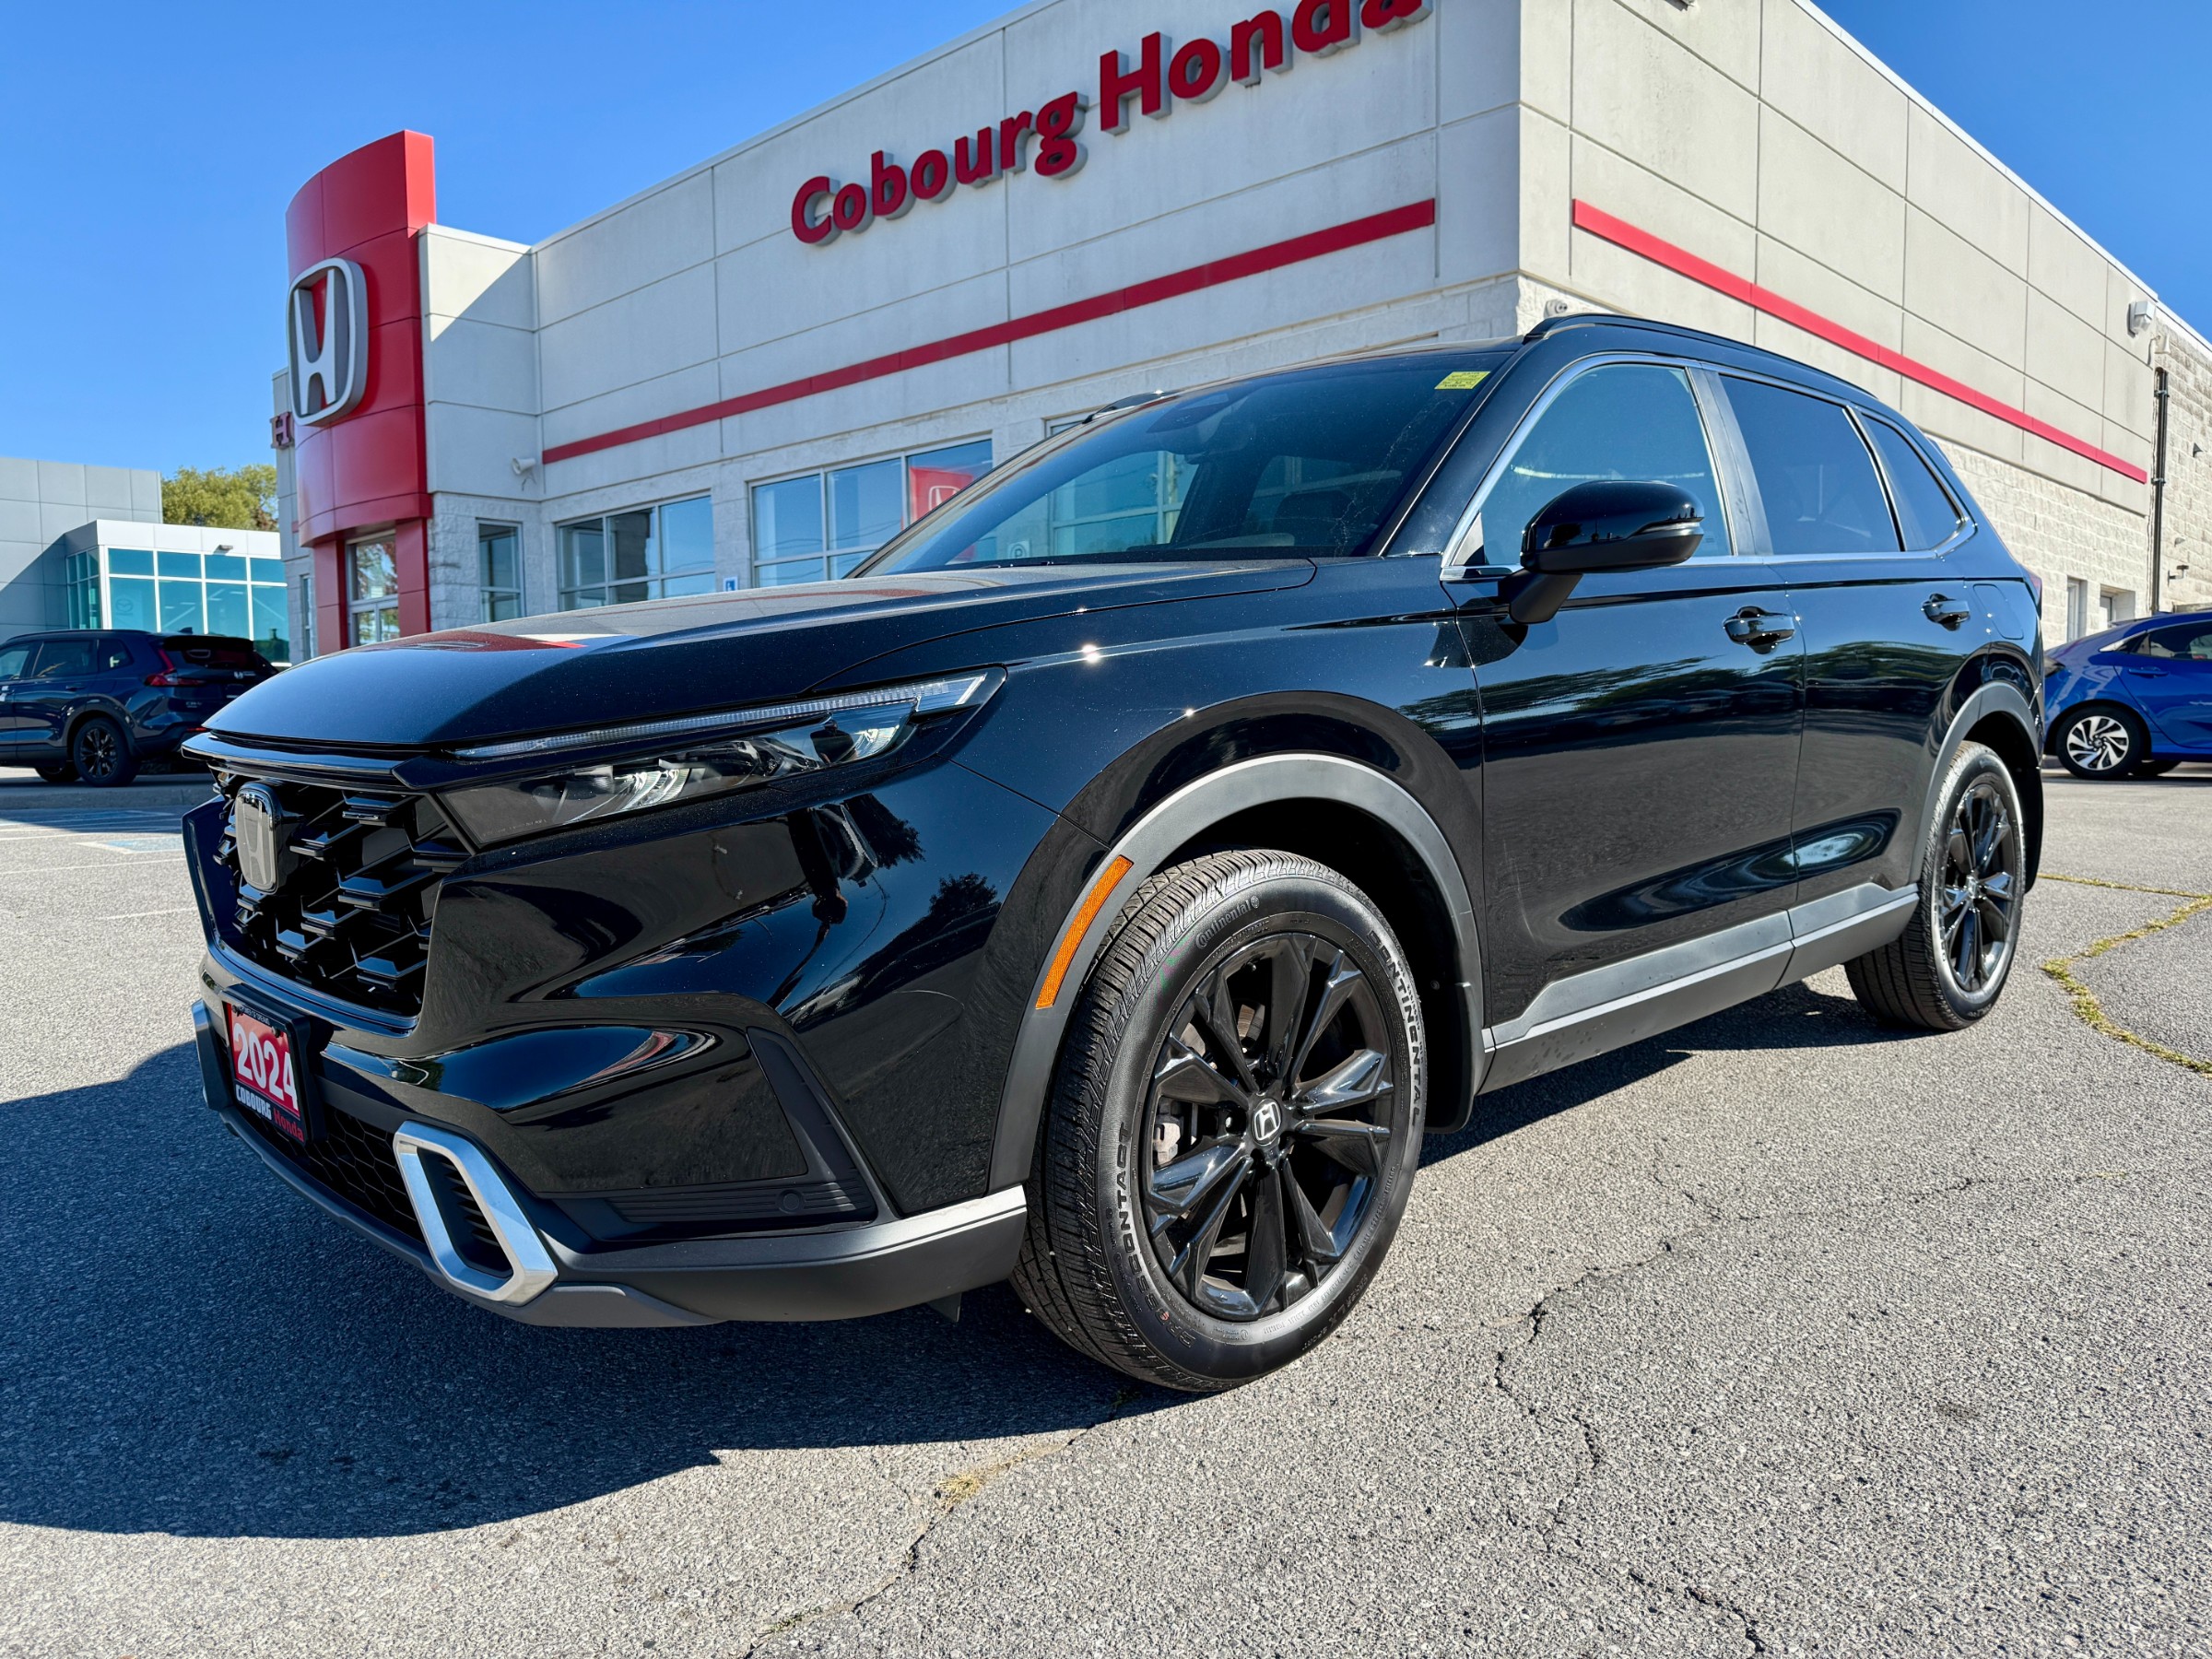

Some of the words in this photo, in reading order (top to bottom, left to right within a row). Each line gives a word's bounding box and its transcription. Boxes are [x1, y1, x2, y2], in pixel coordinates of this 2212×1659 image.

[791, 90, 1086, 244] Cobourg
[1195, 897, 1253, 949] Continental
[233, 1022, 299, 1112] 2024
[1367, 930, 1421, 1126] CONTINENTAL
[235, 1084, 272, 1121] COBOURG
[273, 1107, 305, 1143] Honda
[1116, 1122, 1196, 1347] CROSSCONTACT
